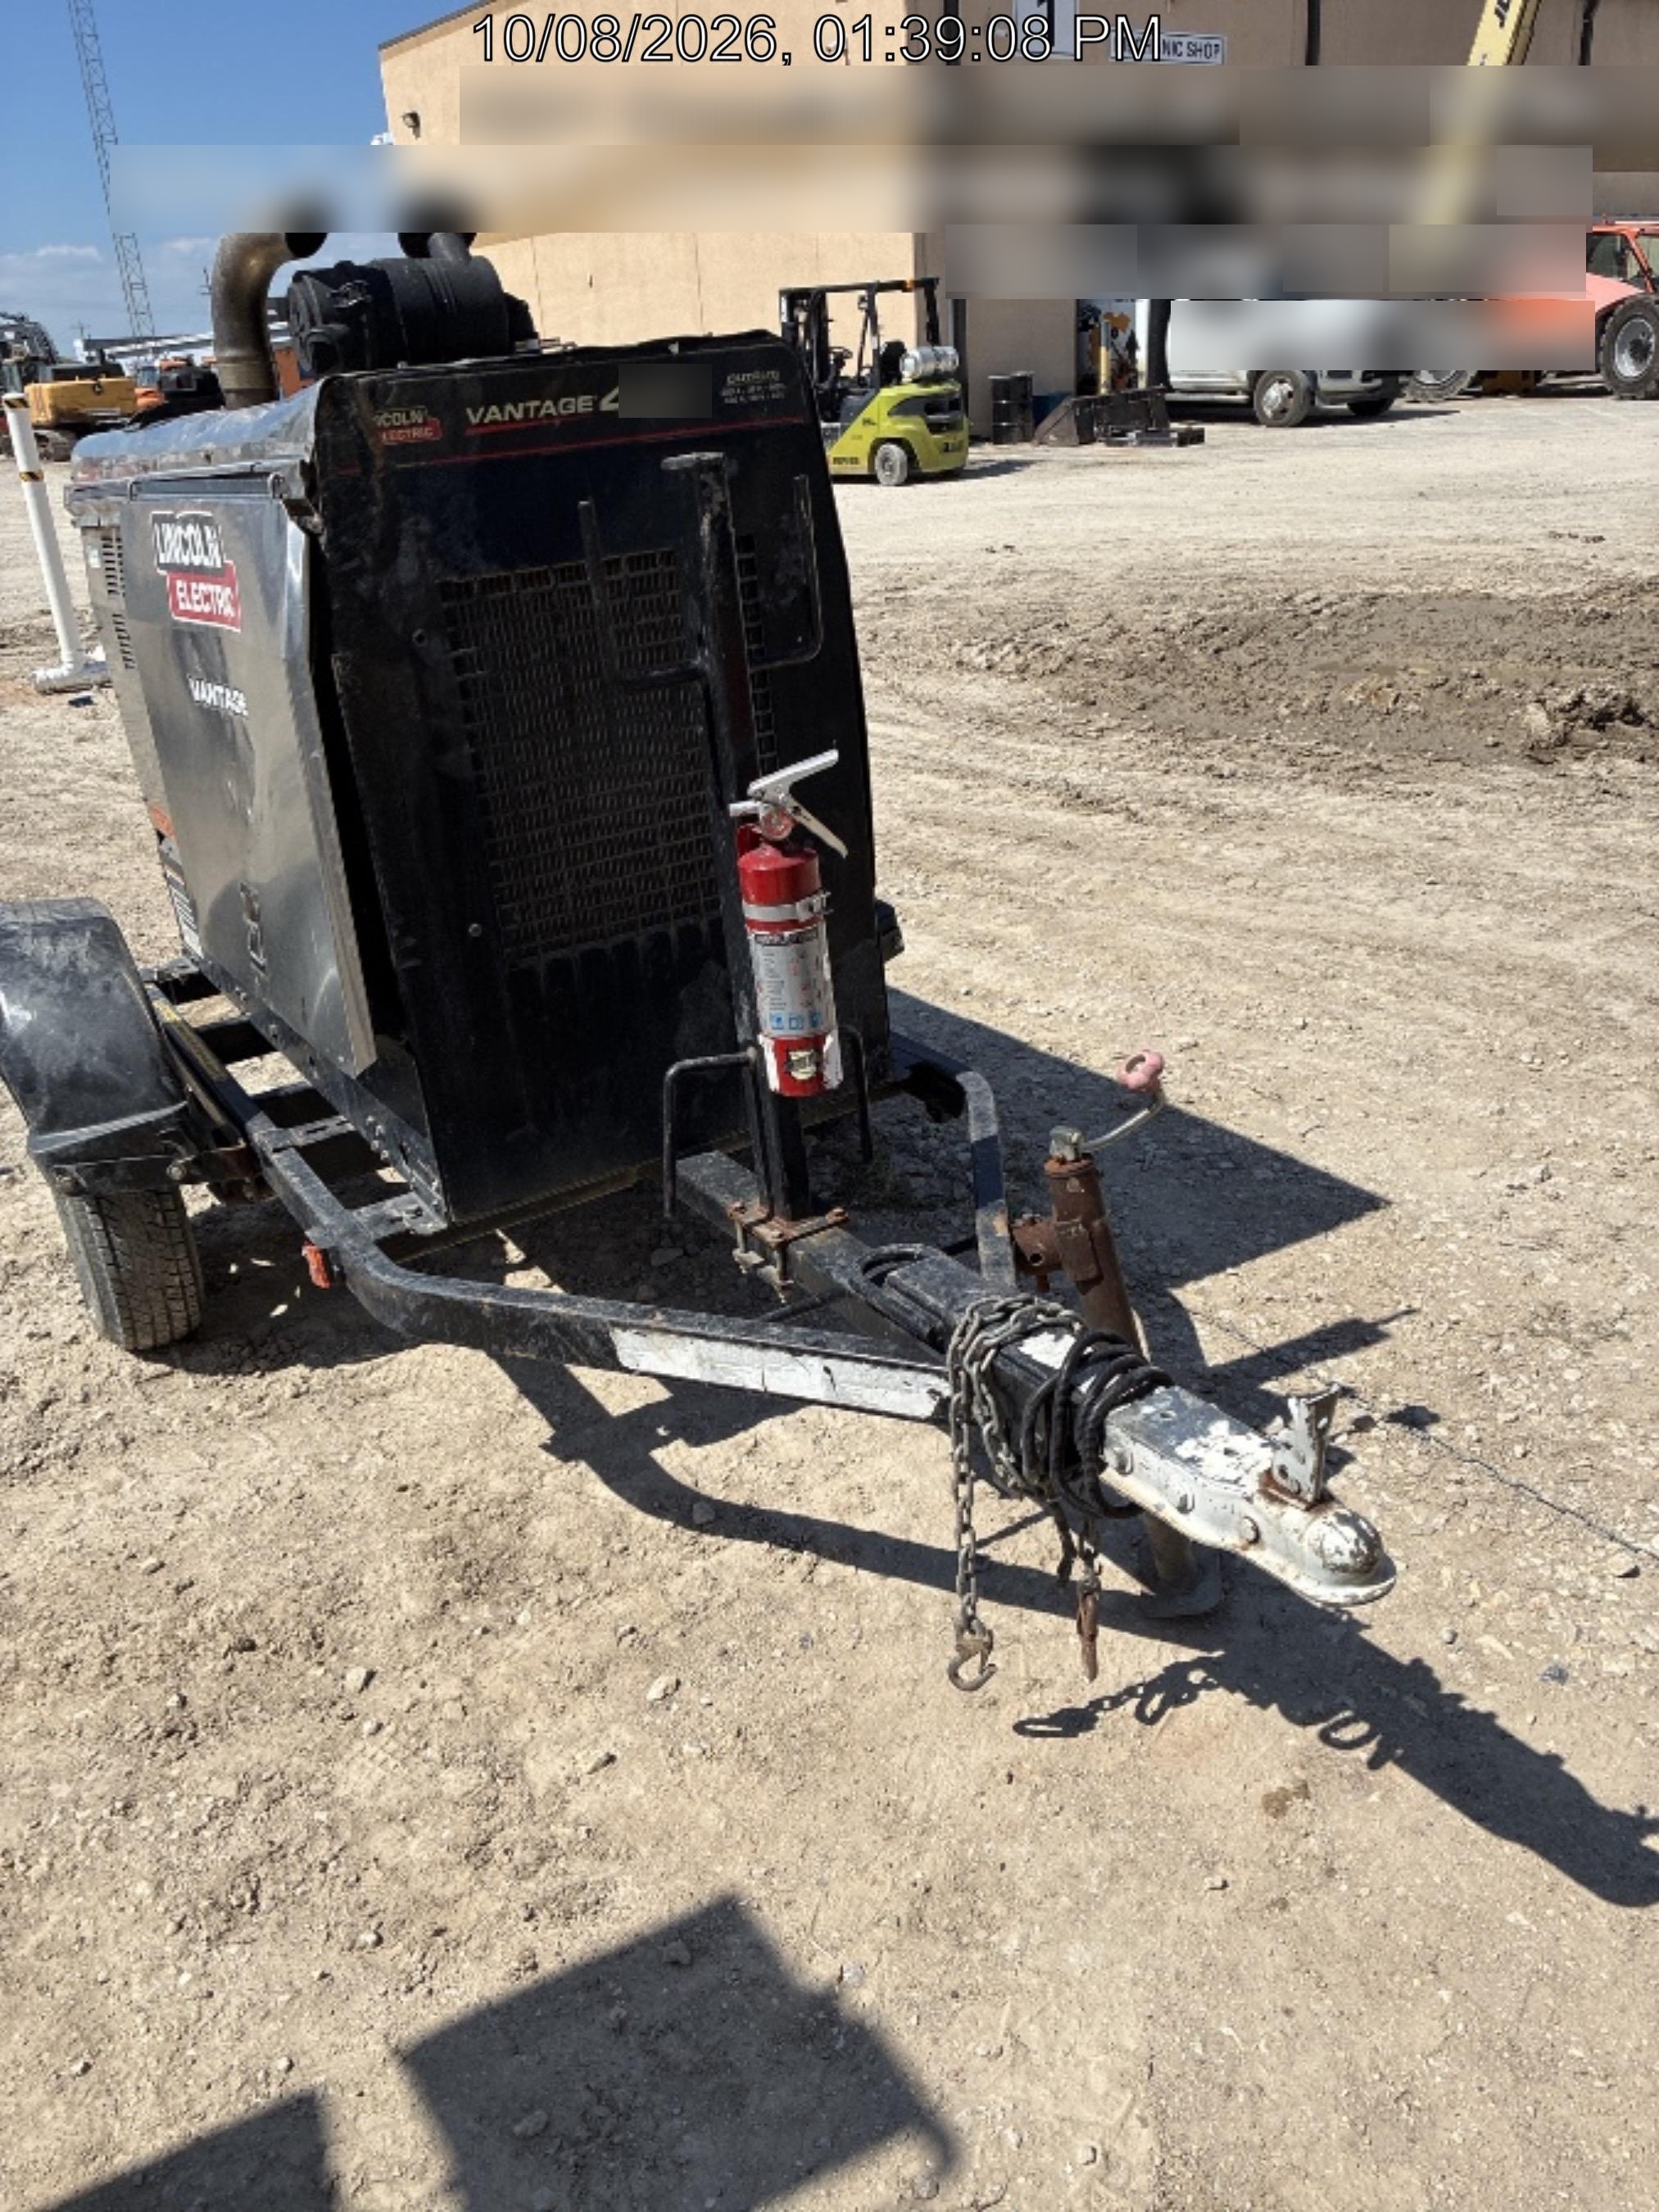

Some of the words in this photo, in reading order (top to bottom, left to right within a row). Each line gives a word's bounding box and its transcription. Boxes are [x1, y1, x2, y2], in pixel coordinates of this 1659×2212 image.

[1186, 40, 1220, 60] SHOP
[465, 395, 594, 425] VANTAGE
[153, 521, 224, 569] LINCOLN
[175, 578, 235, 618] ELECTRIC
[188, 673, 248, 717] VANTAGE
